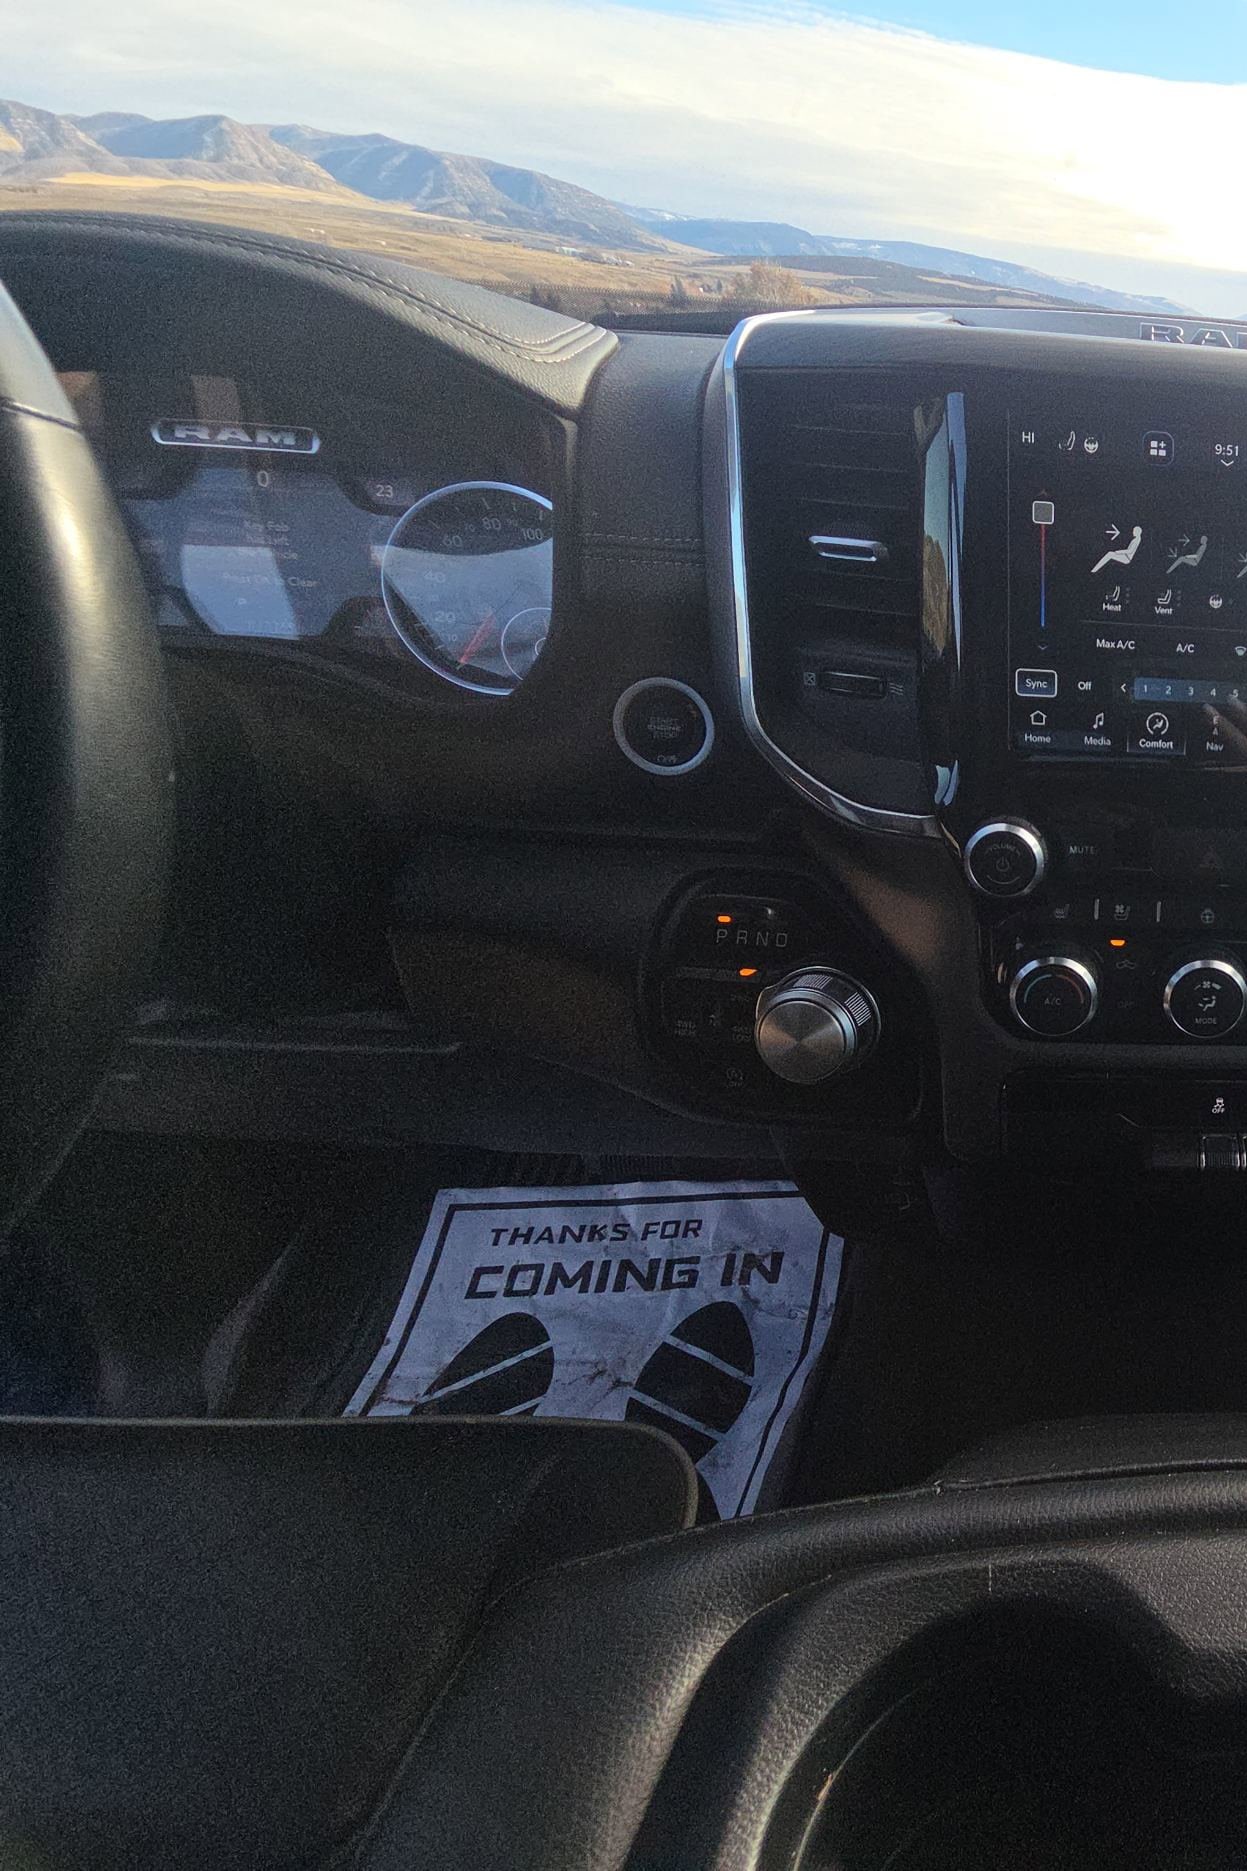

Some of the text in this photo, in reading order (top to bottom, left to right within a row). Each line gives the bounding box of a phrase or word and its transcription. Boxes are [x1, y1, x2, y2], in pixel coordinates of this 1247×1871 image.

[173, 424, 297, 447] RAM
[1021, 431, 1035, 444] HI
[1214, 443, 1240, 457] 9:51
[255, 470, 270, 488] 0
[374, 483, 395, 498] 23
[481, 516, 502, 531] 80
[521, 527, 544, 541] 100
[442, 534, 463, 547] 60
[1102, 602, 1122, 612] Heat
[1154, 606, 1173, 615] Vent
[434, 610, 456, 623] 20
[1096, 639, 1136, 651] Max A/C
[1176, 643, 1195, 654] A/C
[1025, 677, 1048, 690] Sync
[1077, 680, 1093, 691] Off
[1142, 684, 1148, 693] 1
[1165, 685, 1172, 695] 2
[1188, 686, 1194, 696] 3
[1210, 687, 1217, 697] 4
[1024, 734, 1051, 744] Home
[1084, 736, 1111, 747] Media
[1138, 738, 1174, 750] Comfort
[1206, 742, 1224, 752] Nav
[1068, 845, 1096, 855] MUTE
[1043, 996, 1062, 1007] A/C
[1194, 1017, 1218, 1025] MODE
[1211, 1107, 1226, 1115] OFF
[490, 1219, 704, 1247] THANKS FOR
[463, 1251, 785, 1300] COMING IN
